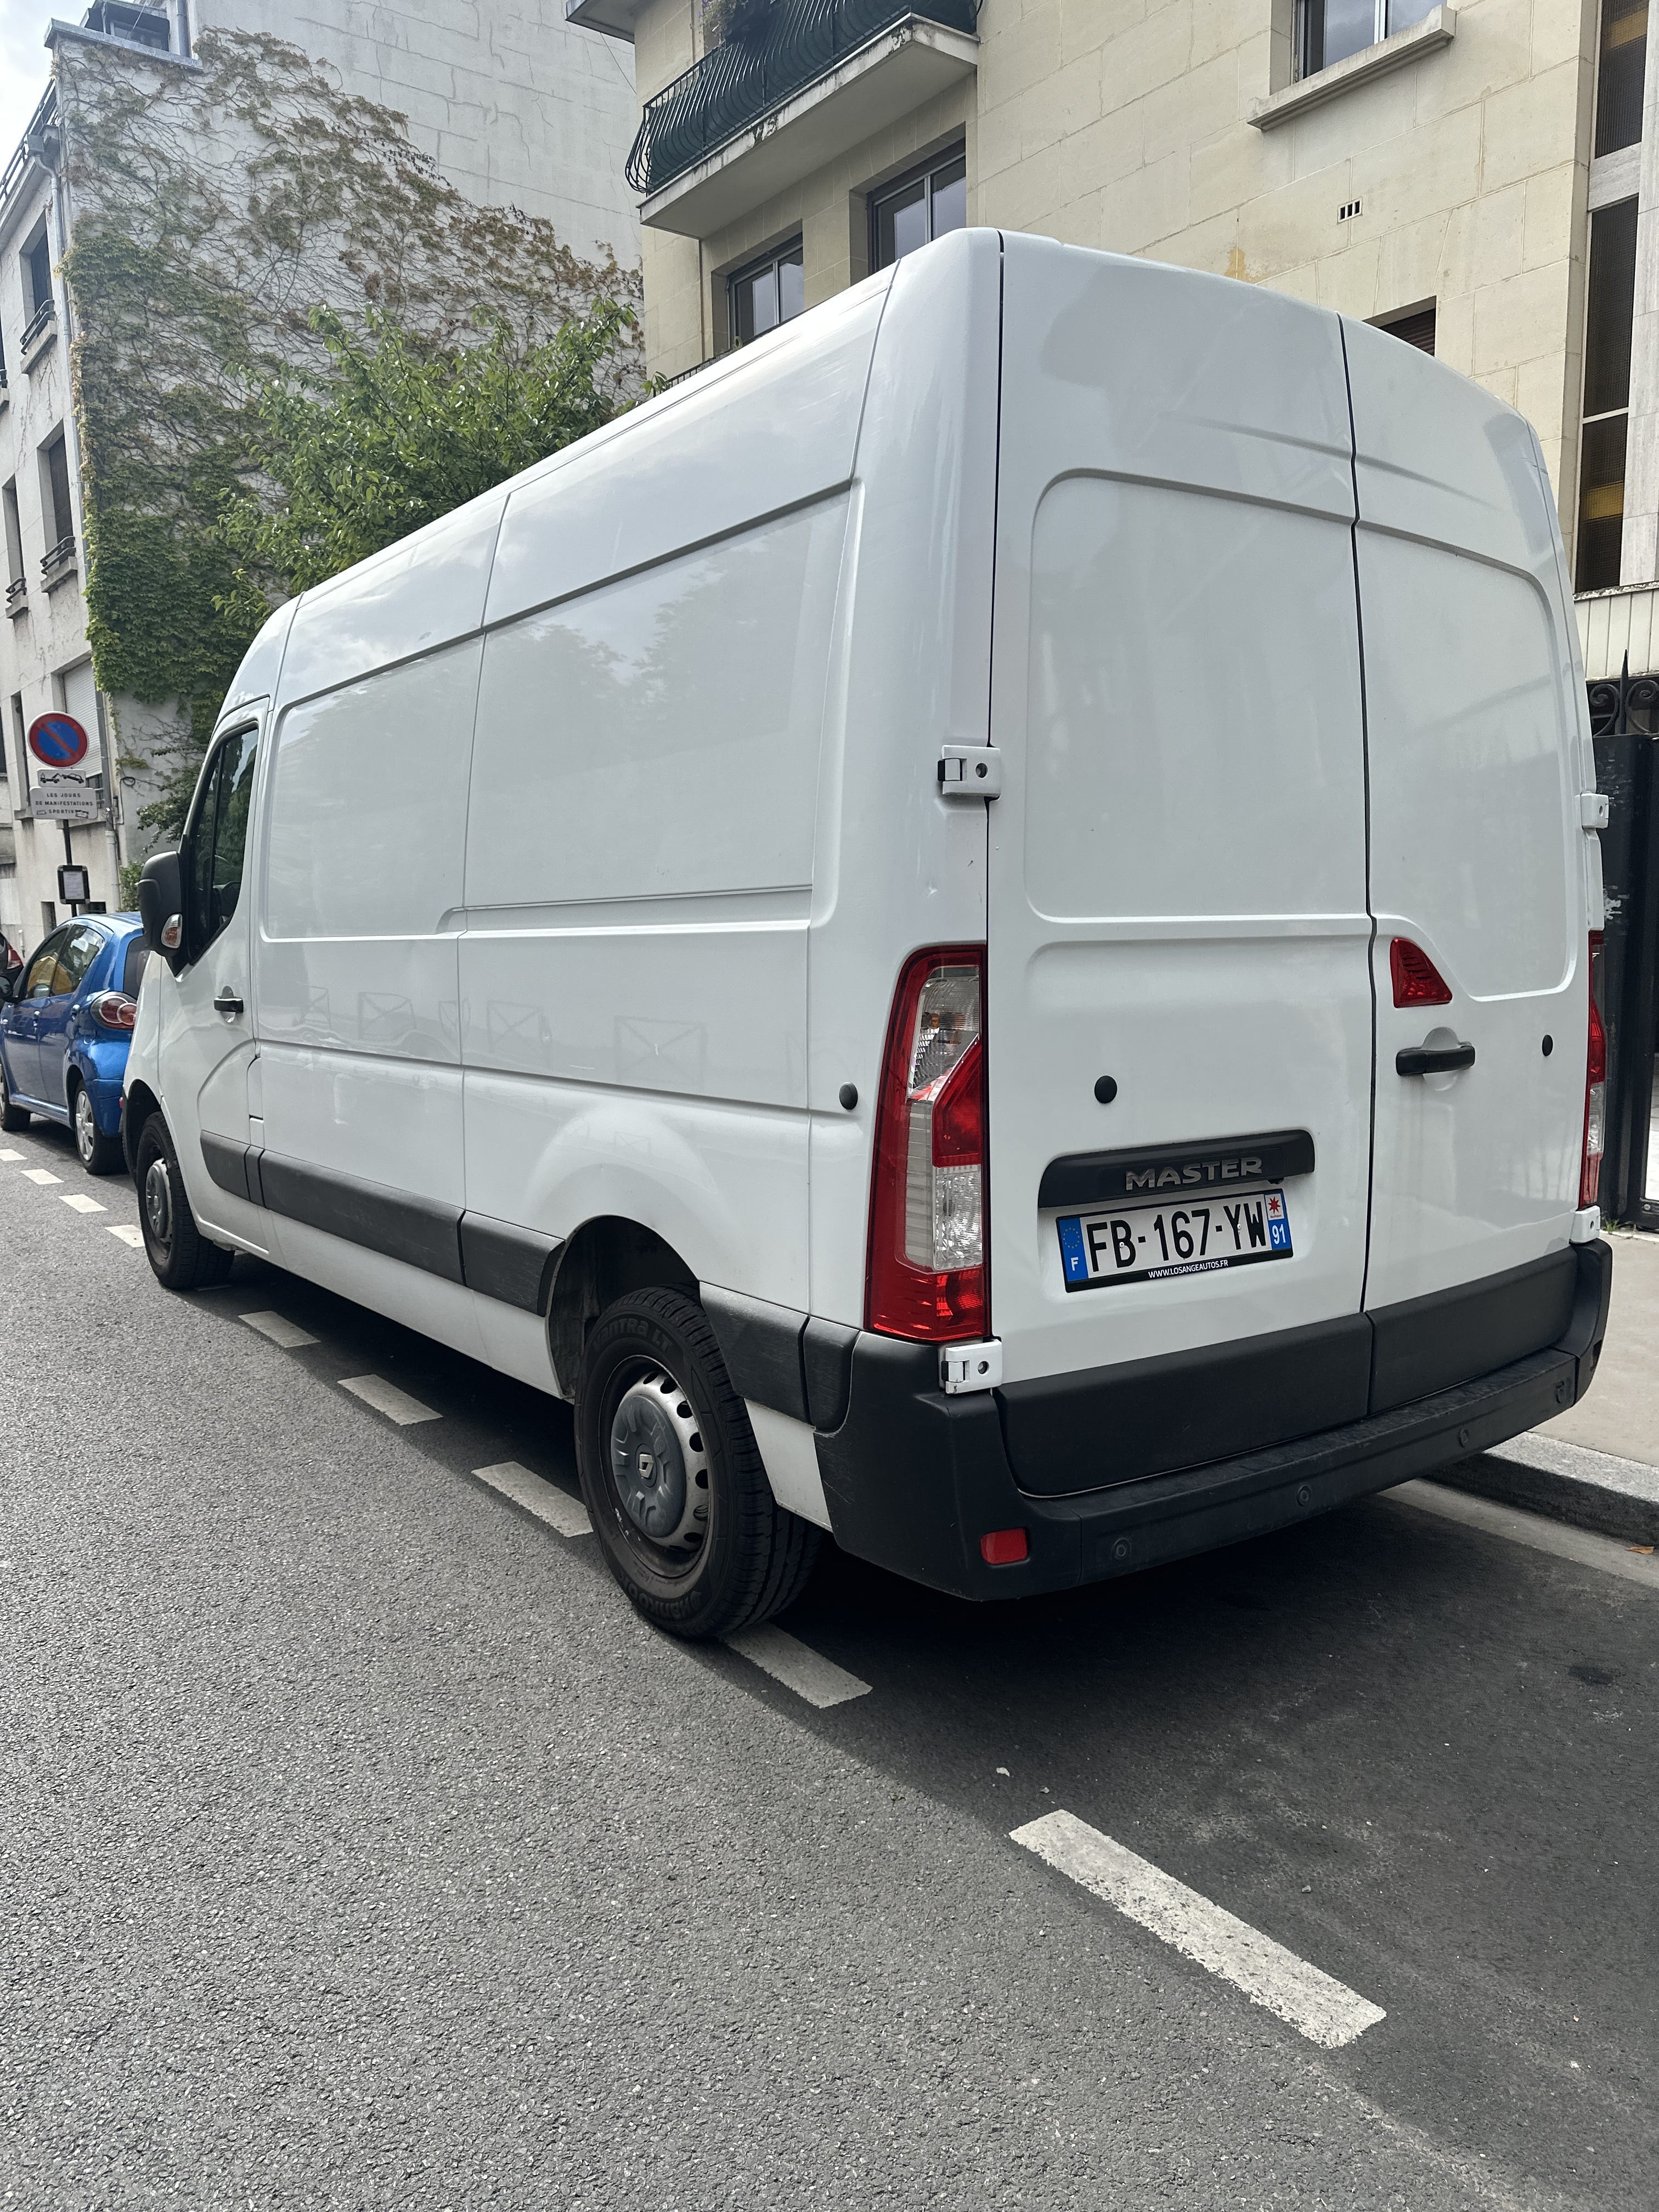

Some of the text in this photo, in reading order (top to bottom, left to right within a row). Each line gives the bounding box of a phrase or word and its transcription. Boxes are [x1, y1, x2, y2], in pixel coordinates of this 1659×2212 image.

[1125, 1156, 1263, 1191] MASTER
[1086, 1201, 1267, 1273] FB-167-YW
[1272, 1223, 1286, 1245] 91
[1070, 1257, 1079, 1271] F
[1148, 1260, 1229, 1279] WWW.LOSANGEAUTOS.FR
